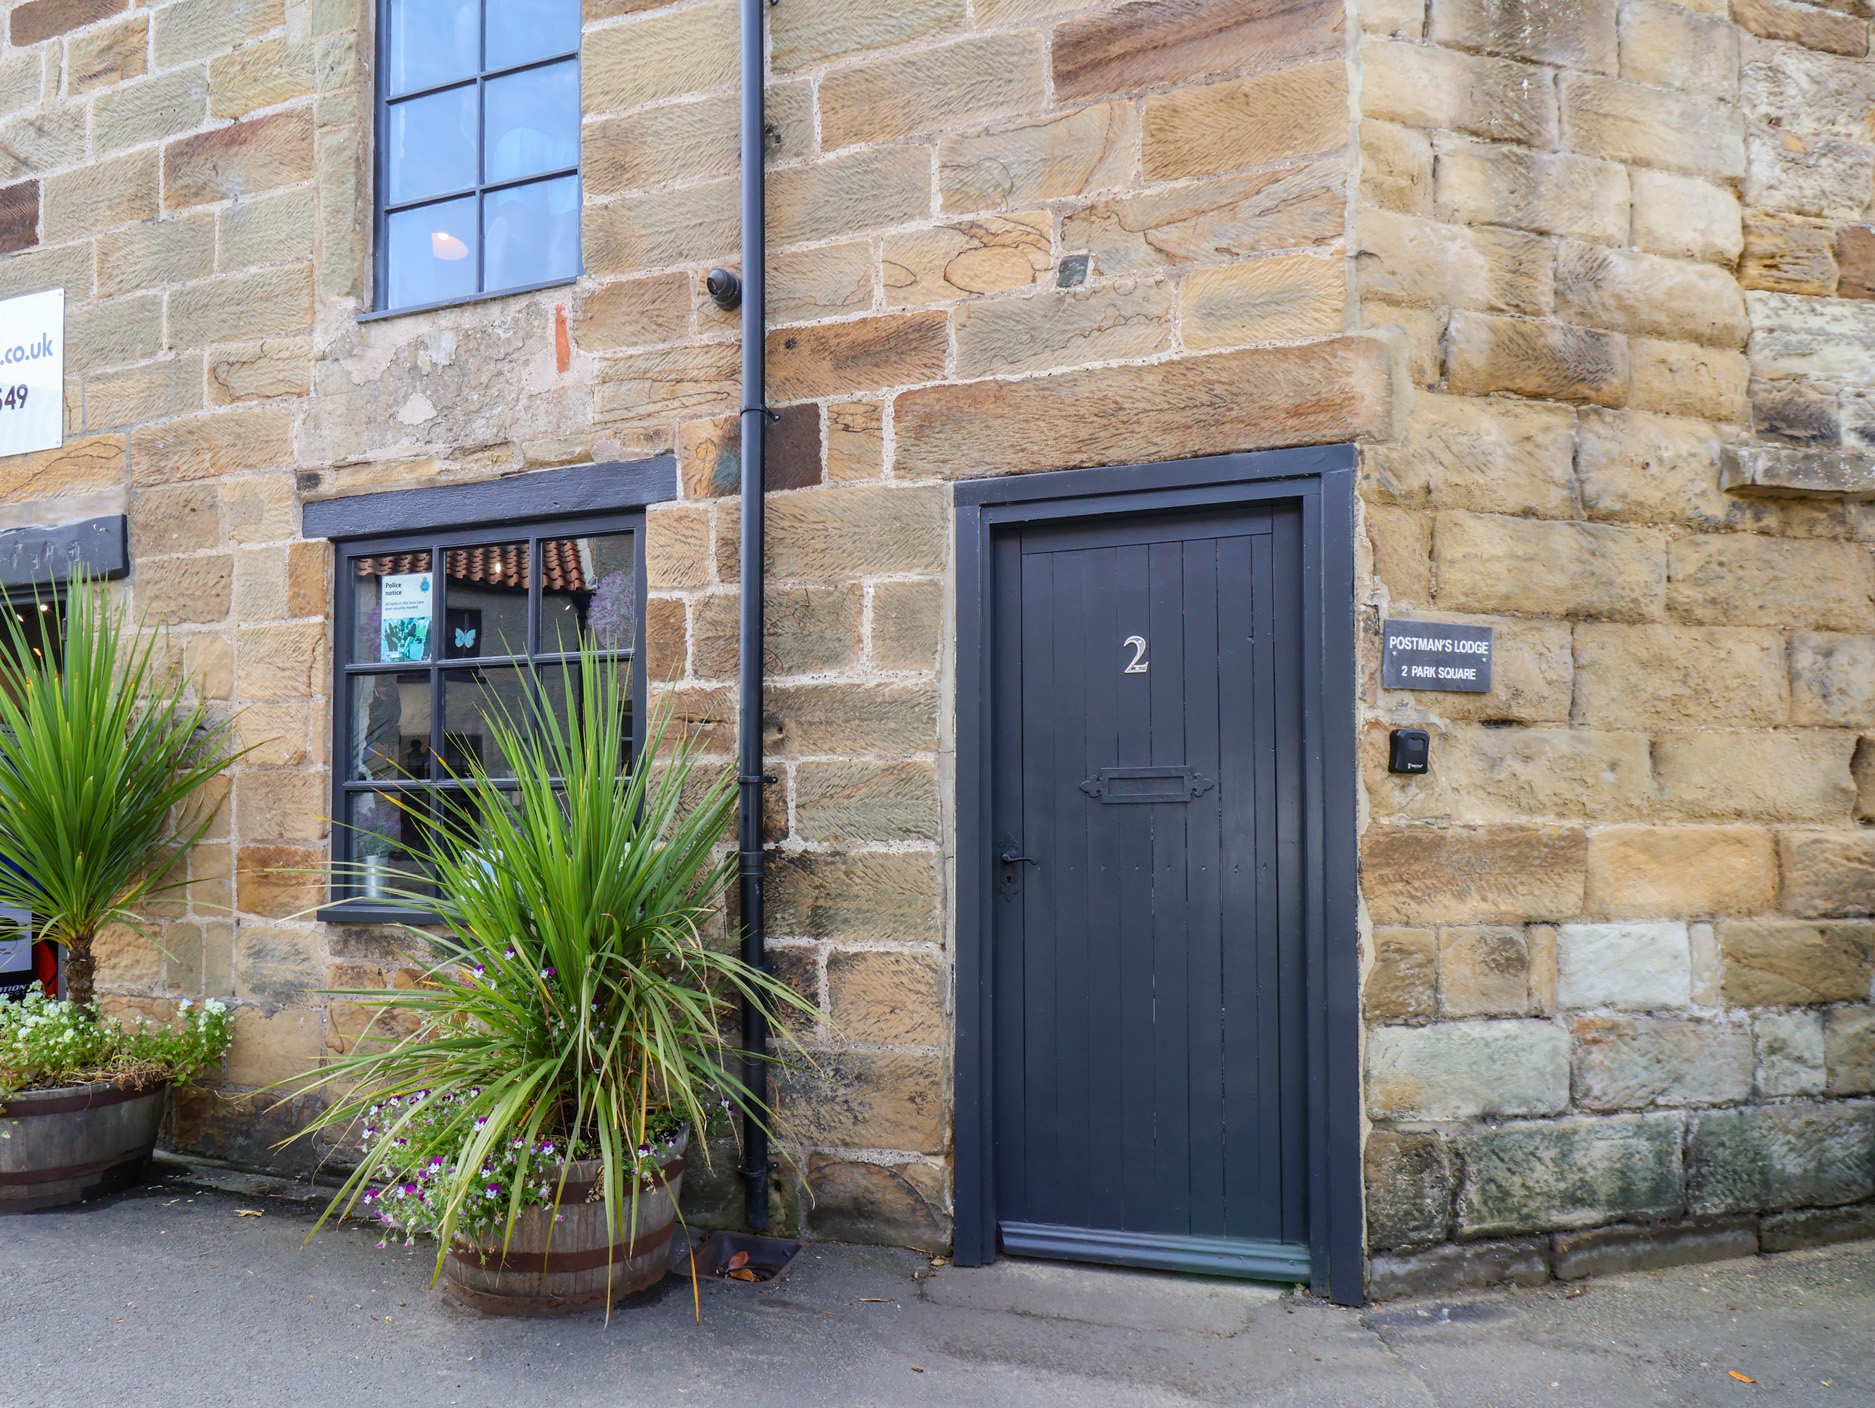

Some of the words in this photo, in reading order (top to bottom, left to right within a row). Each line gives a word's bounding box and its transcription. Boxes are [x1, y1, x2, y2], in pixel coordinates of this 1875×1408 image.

[0, 332, 53, 366] .co.uk
[0, 383, 29, 411] 49
[1123, 635, 1149, 674] 2
[1389, 636, 1453, 652] POSTMAN'S
[1454, 640, 1489, 655] LODGE
[1401, 665, 1408, 677] 2
[1411, 665, 1436, 678] PARK
[1437, 667, 1477, 680] SQUARE
